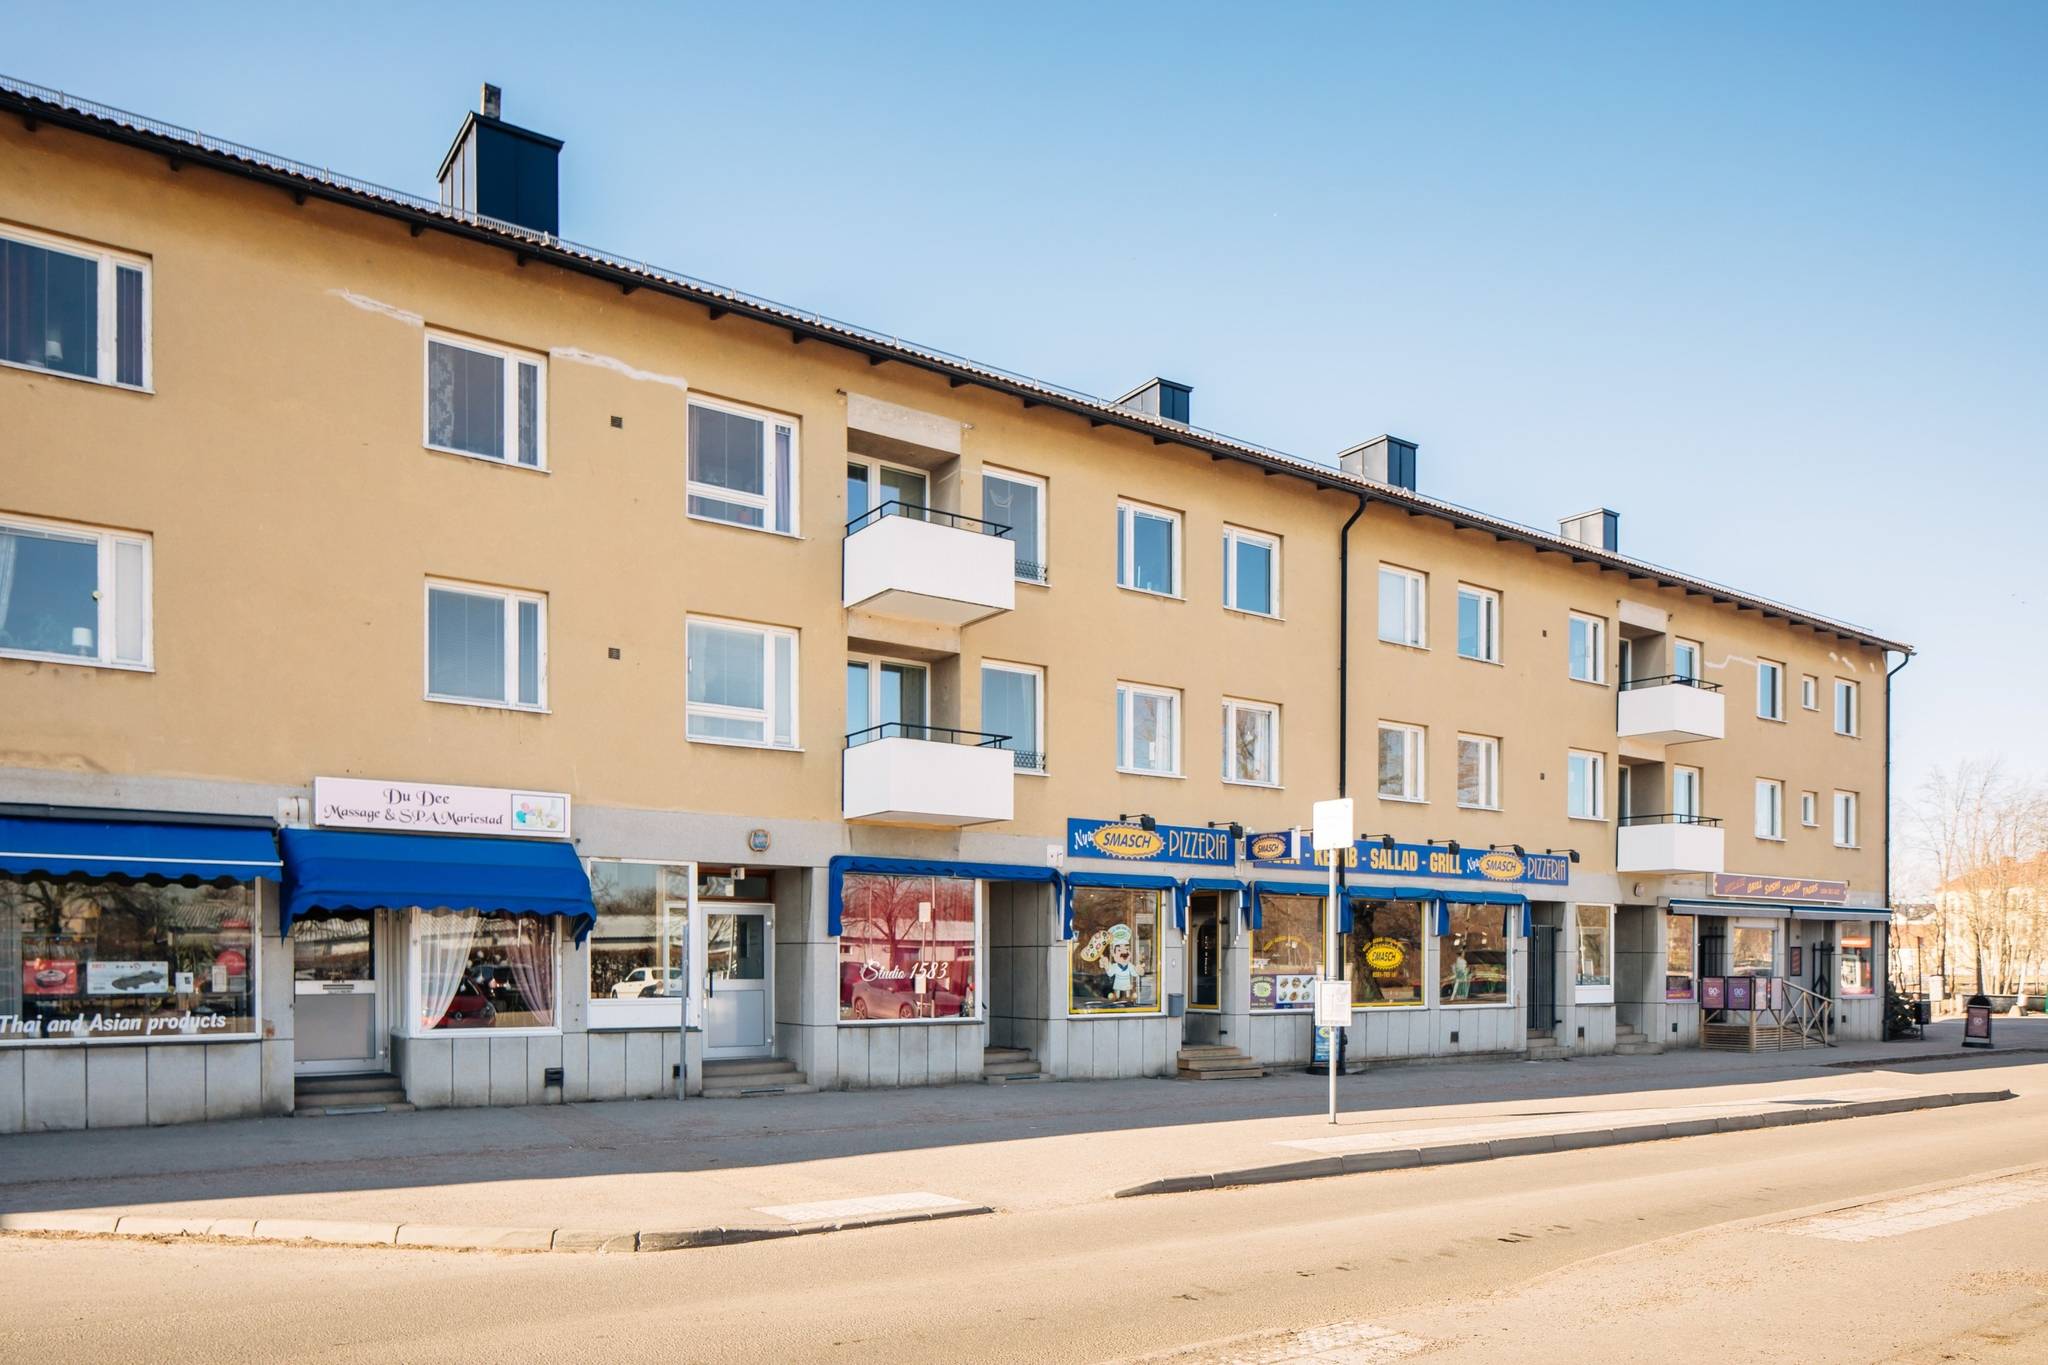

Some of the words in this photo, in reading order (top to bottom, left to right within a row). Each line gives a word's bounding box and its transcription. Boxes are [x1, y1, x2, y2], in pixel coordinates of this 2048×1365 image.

[383, 788, 411, 805] Du
[416, 790, 451, 806] Dee
[324, 804, 381, 823] Massage
[385, 809, 396, 822] &
[400, 808, 440, 824] SPA
[441, 809, 504, 826] Mariestad
[1102, 832, 1152, 849] SMASCH
[1169, 829, 1228, 861] PIZZERIA
[1370, 848, 1418, 872] SALLAD
[1430, 852, 1463, 875] GRILL
[1486, 859, 1517, 873] SMASCH
[1527, 856, 1566, 881] PIZZERIA
[1371, 951, 1397, 962] SMASCH
[860, 960, 906, 982] Studio
[909, 961, 949, 980] 1583
[0, 1012, 43, 1034] Thai
[46, 1013, 84, 1033] and
[89, 1012, 142, 1033] Asian
[146, 1010, 227, 1035] products
